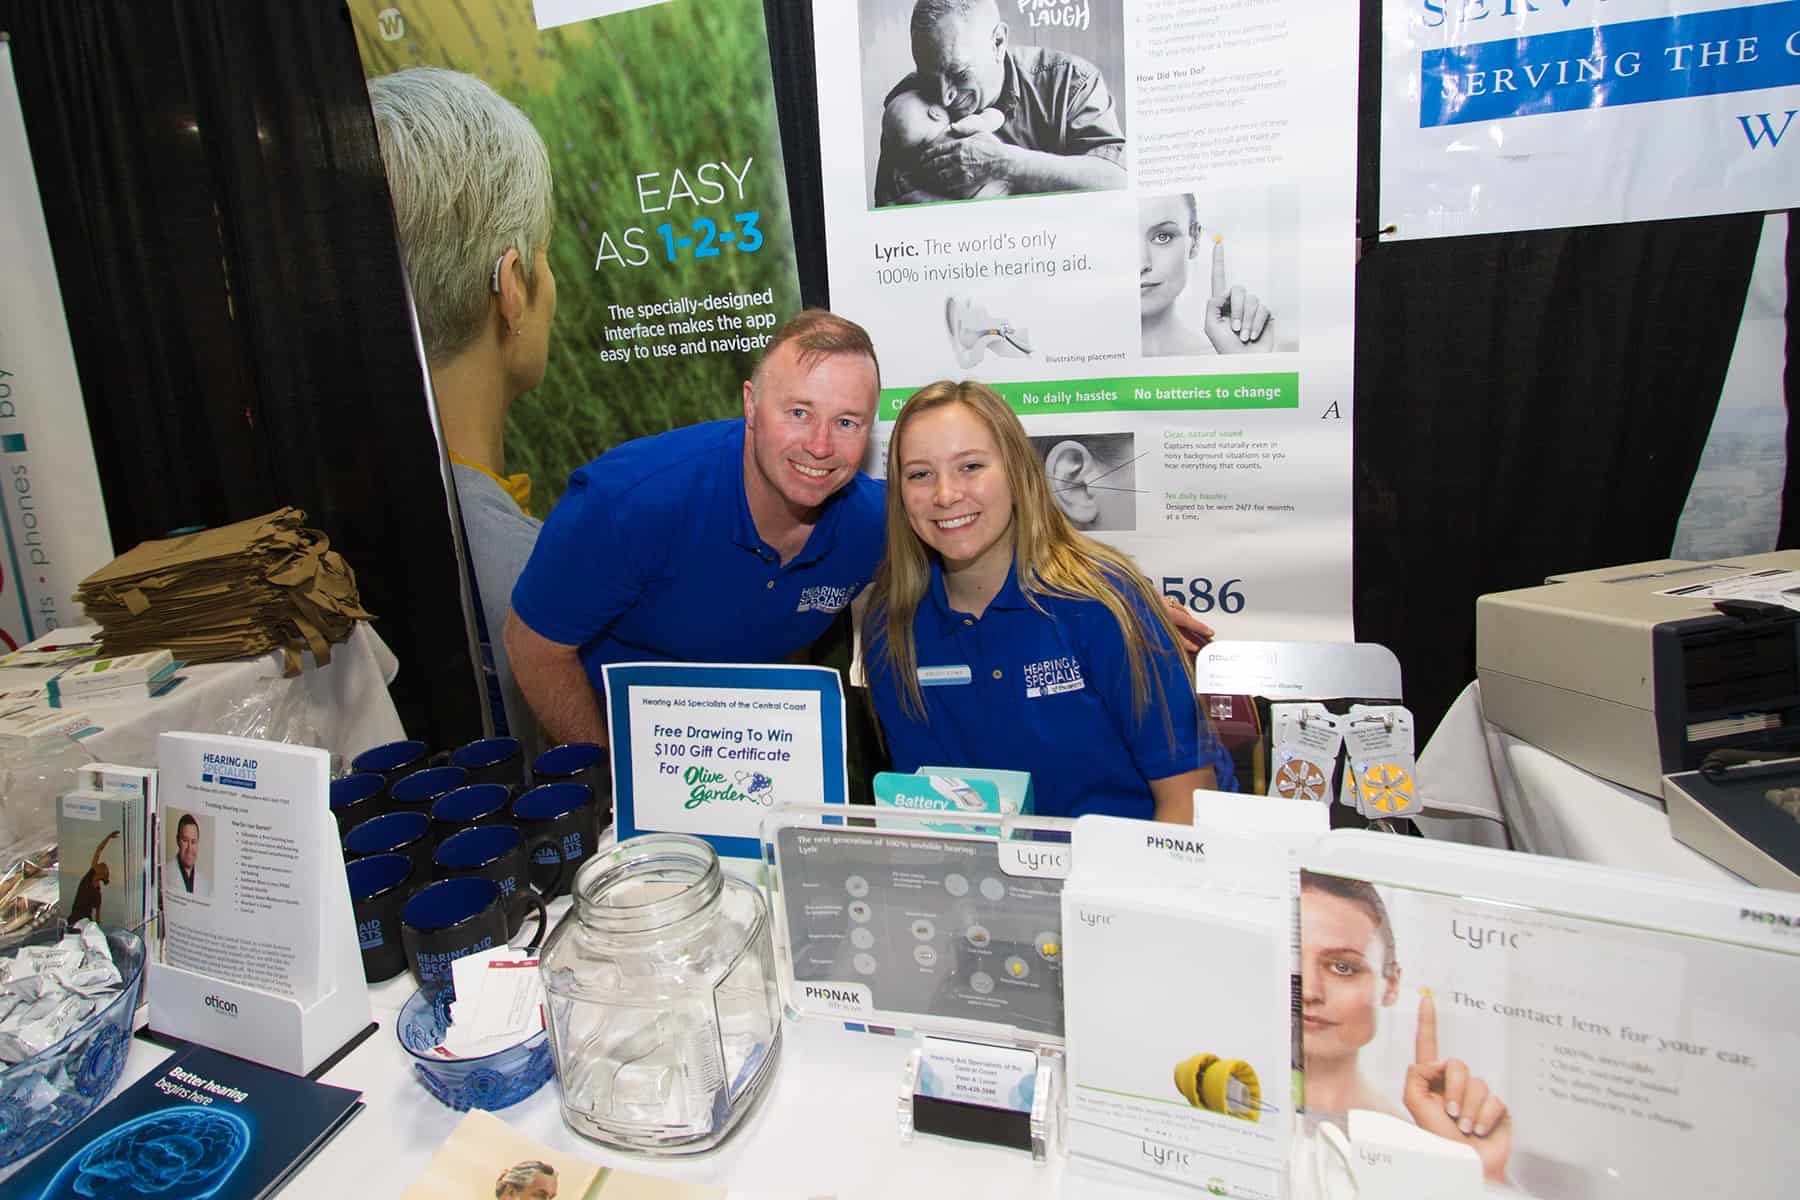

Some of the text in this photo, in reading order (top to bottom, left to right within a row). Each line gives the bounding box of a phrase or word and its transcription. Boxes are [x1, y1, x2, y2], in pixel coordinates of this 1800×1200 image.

[1029, 0, 1089, 31] LAUGH
[1136, 65, 1206, 82] How Did You Do?
[1441, 36, 1759, 98] SERVING THE
[636, 157, 753, 213] EASY
[595, 211, 764, 271] AS 1-2-3
[874, 230, 1057, 263] Lyric. The world's only
[875, 254, 1092, 285] 100% invisible hearing aid.
[607, 288, 773, 321] The specially-designed
[604, 313, 777, 342] interface makes the app
[600, 348, 631, 363] easy
[634, 344, 650, 359] to
[652, 343, 677, 357] use
[680, 338, 707, 354] and
[1045, 351, 1126, 364] Illustrating placement
[1023, 392, 1039, 404] No
[1043, 391, 1072, 406] daily
[1075, 389, 1118, 402] hassles
[1135, 388, 1151, 400] No
[1155, 386, 1211, 400] batteries
[1215, 387, 1230, 398] to
[1234, 386, 1281, 400] change
[1321, 400, 1342, 419] A
[1164, 442, 1194, 450] Captures
[1195, 441, 1217, 449] sound
[1219, 440, 1250, 449] naturally
[1183, 452, 1223, 461] background
[1225, 451, 1259, 459] situations
[1271, 453, 1286, 461] you
[1181, 462, 1217, 471] everything
[1219, 461, 1234, 469] that
[1236, 462, 1262, 470] counts.
[12, 465, 49, 565] phones
[1166, 503, 1195, 512] Designed
[1197, 503, 1205, 511] to
[1206, 503, 1215, 511] be
[1235, 503, 1252, 512] 24/7
[1253, 503, 1265, 511] for
[1267, 503, 1295, 511] months
[1181, 513, 1200, 521] time.
[1143, 576, 1245, 614] 586
[1024, 657, 1070, 675] HEARING
[643, 698, 671, 708] Hearing
[674, 699, 686, 707] Aid
[688, 700, 727, 709] Specialists
[752, 702, 781, 710] Central
[783, 703, 806, 711] Coast
[654, 725, 793, 744] Free Drawing To Win
[203, 752, 258, 769] HEARING AID
[655, 743, 791, 761] $100 Gift Certificate
[202, 763, 257, 780] SPECIALISTS
[659, 762, 727, 786] For Olive
[684, 784, 753, 809] Garden
[894, 793, 949, 810] Battery
[563, 832, 581, 845] AID
[798, 835, 811, 844] The
[1146, 836, 1205, 854] PHONAK
[1016, 849, 1062, 871] Lyric
[359, 919, 380, 931] AID
[1080, 909, 1110, 927] Lyric
[1452, 918, 1518, 950] Lyric
[416, 936, 492, 963] HEARING AID
[204, 995, 238, 1014] oticon
[805, 986, 860, 1004] PHONAK
[1450, 990, 1757, 1070] The contact lens for your ear.
[155, 1077, 213, 1106] begins here
[169, 1066, 248, 1103] Better hearing
[1141, 1140, 1190, 1168] Lyric
